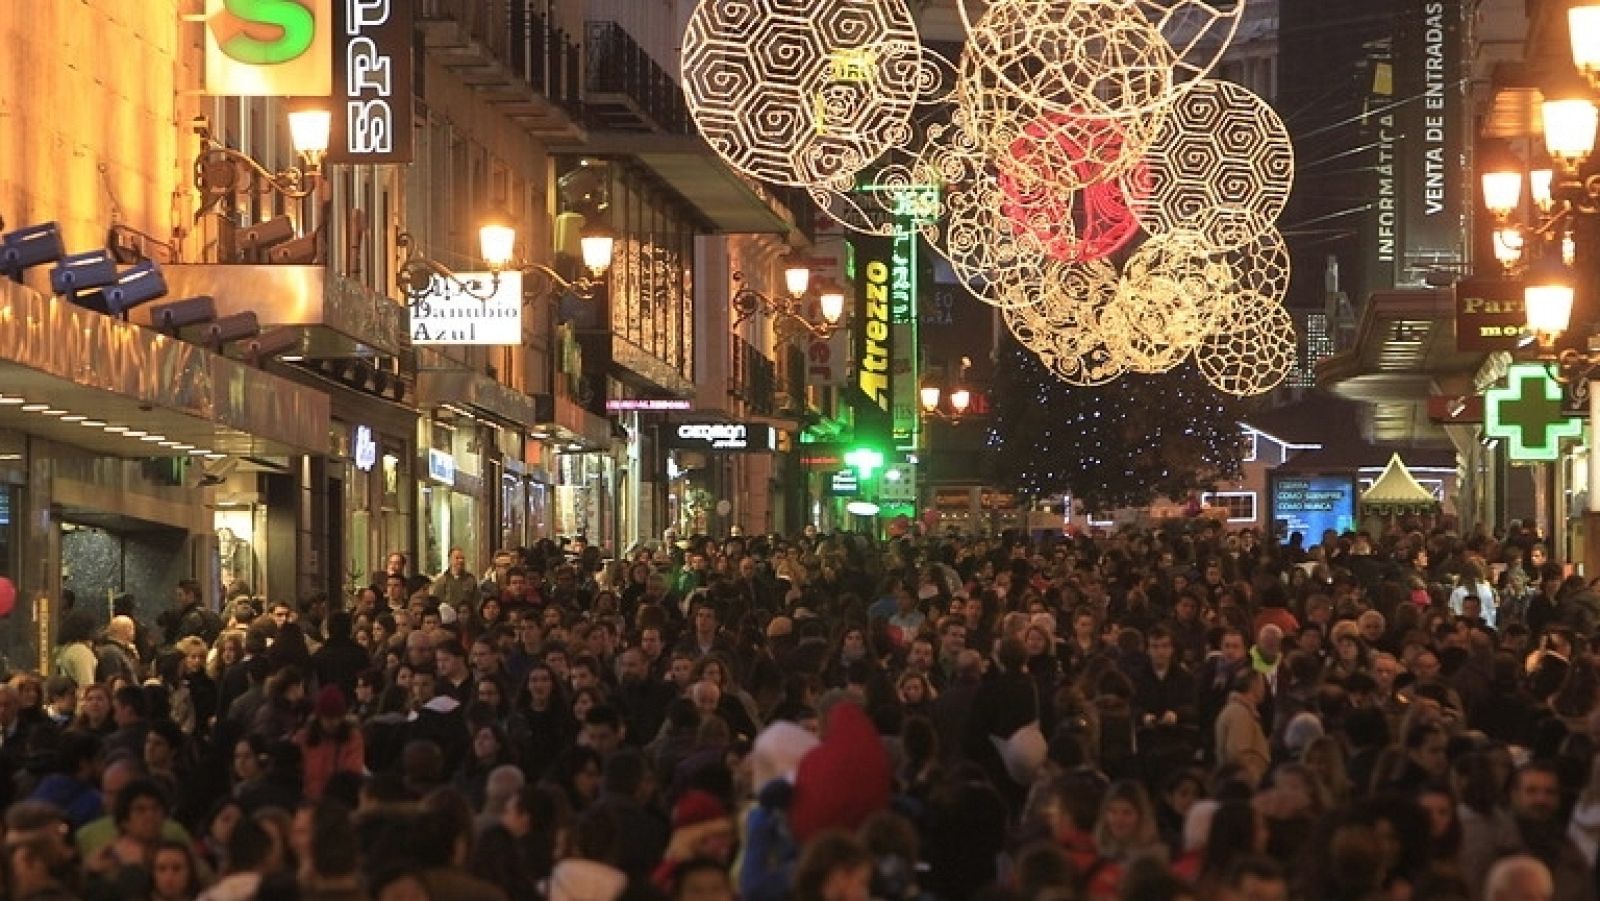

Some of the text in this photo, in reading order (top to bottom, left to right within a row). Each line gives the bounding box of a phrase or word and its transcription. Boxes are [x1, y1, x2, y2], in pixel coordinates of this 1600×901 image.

[1425, 2, 1445, 216] VENTA DE ENTRADAS
[413, 322, 475, 341] Azul
[859, 260, 889, 412] Atrezzo
